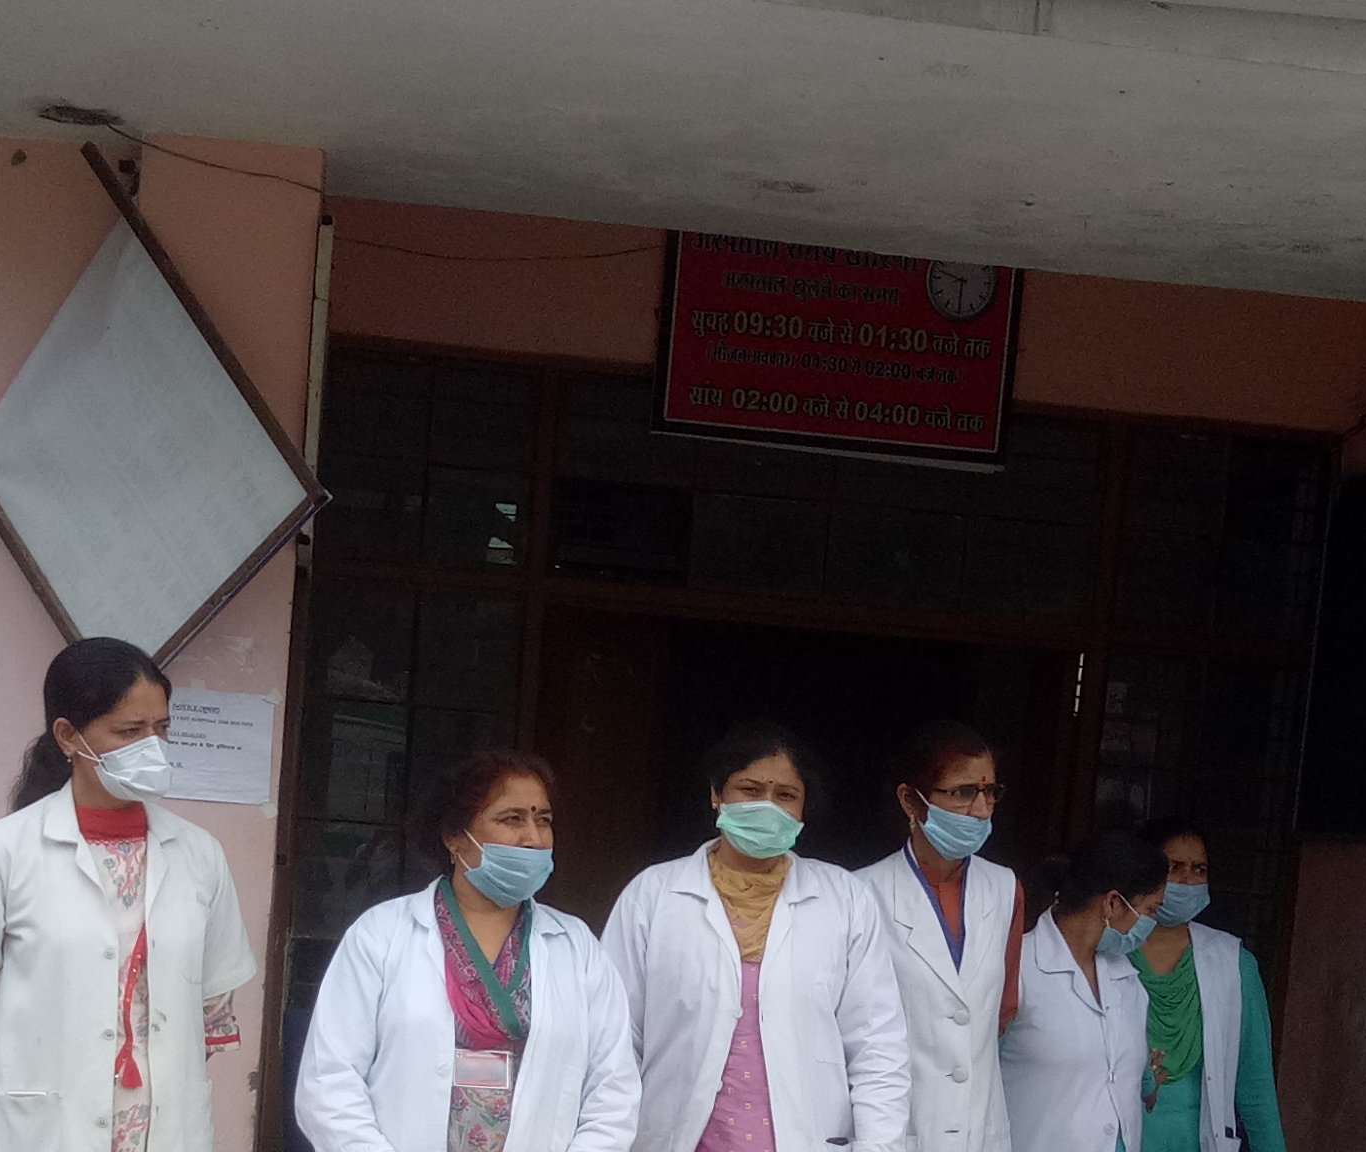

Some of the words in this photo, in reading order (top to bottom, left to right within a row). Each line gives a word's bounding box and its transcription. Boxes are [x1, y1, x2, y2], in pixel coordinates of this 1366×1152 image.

[733, 310, 804, 341] 09:30
[858, 323, 928, 353] 01:30
[732, 388, 799, 415] 02:00
[854, 400, 921, 427] 04:00
